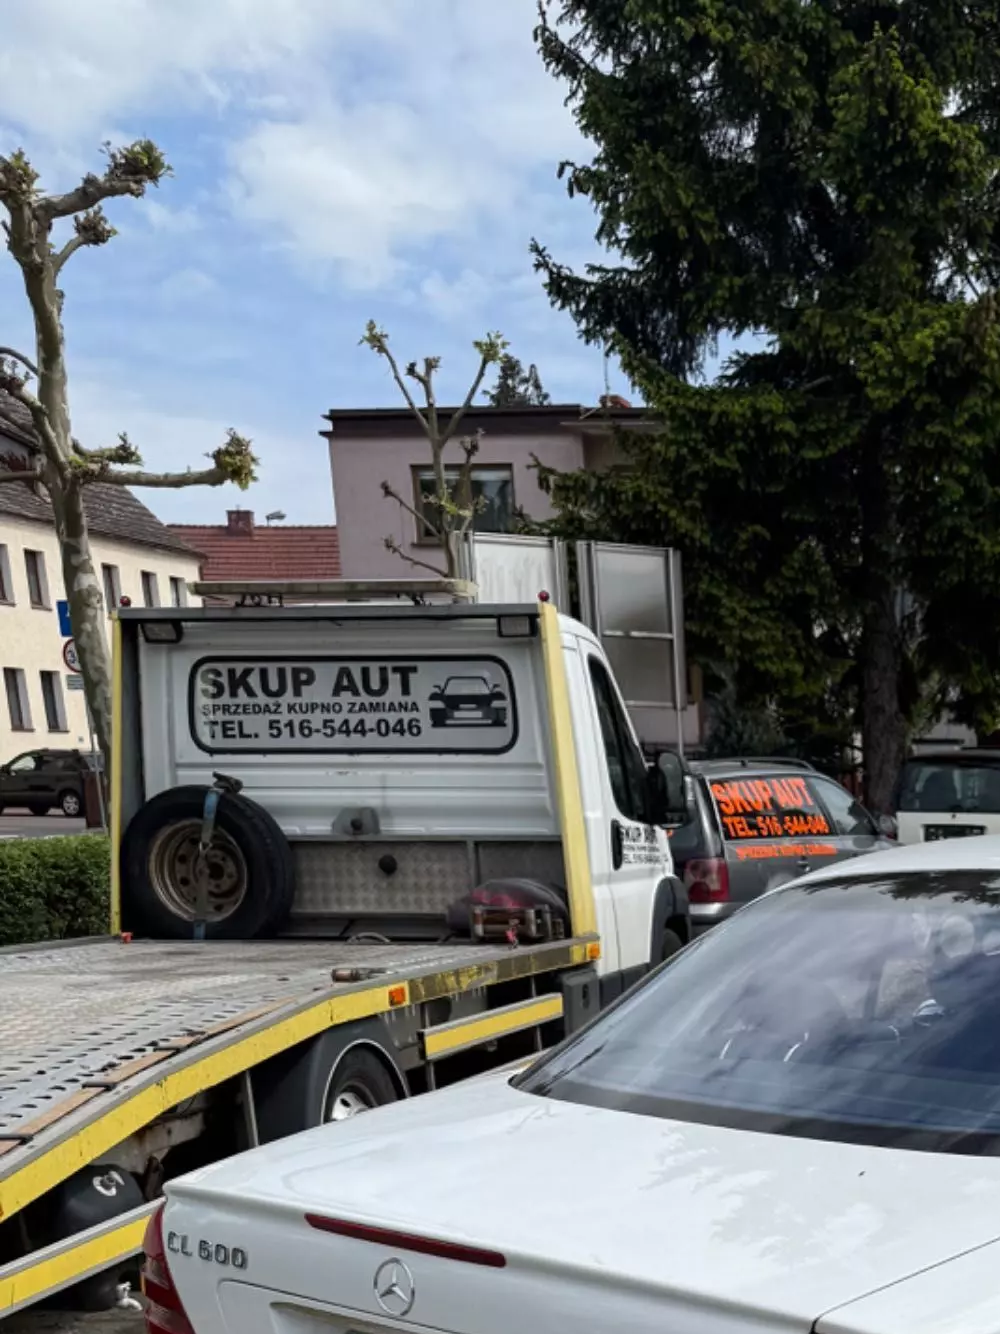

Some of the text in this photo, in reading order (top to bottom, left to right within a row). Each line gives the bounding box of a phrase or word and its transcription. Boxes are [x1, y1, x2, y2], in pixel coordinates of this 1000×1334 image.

[200, 666, 418, 699] SKUP AUT
[202, 701, 420, 716] SPRZEDAŻ KUPNO ZAMIANA
[203, 717, 422, 740] TEL. 516-544-046
[711, 776, 815, 816] SKUP AUT
[723, 816, 758, 838] TEL.
[167, 1231, 248, 1271] CL 600
